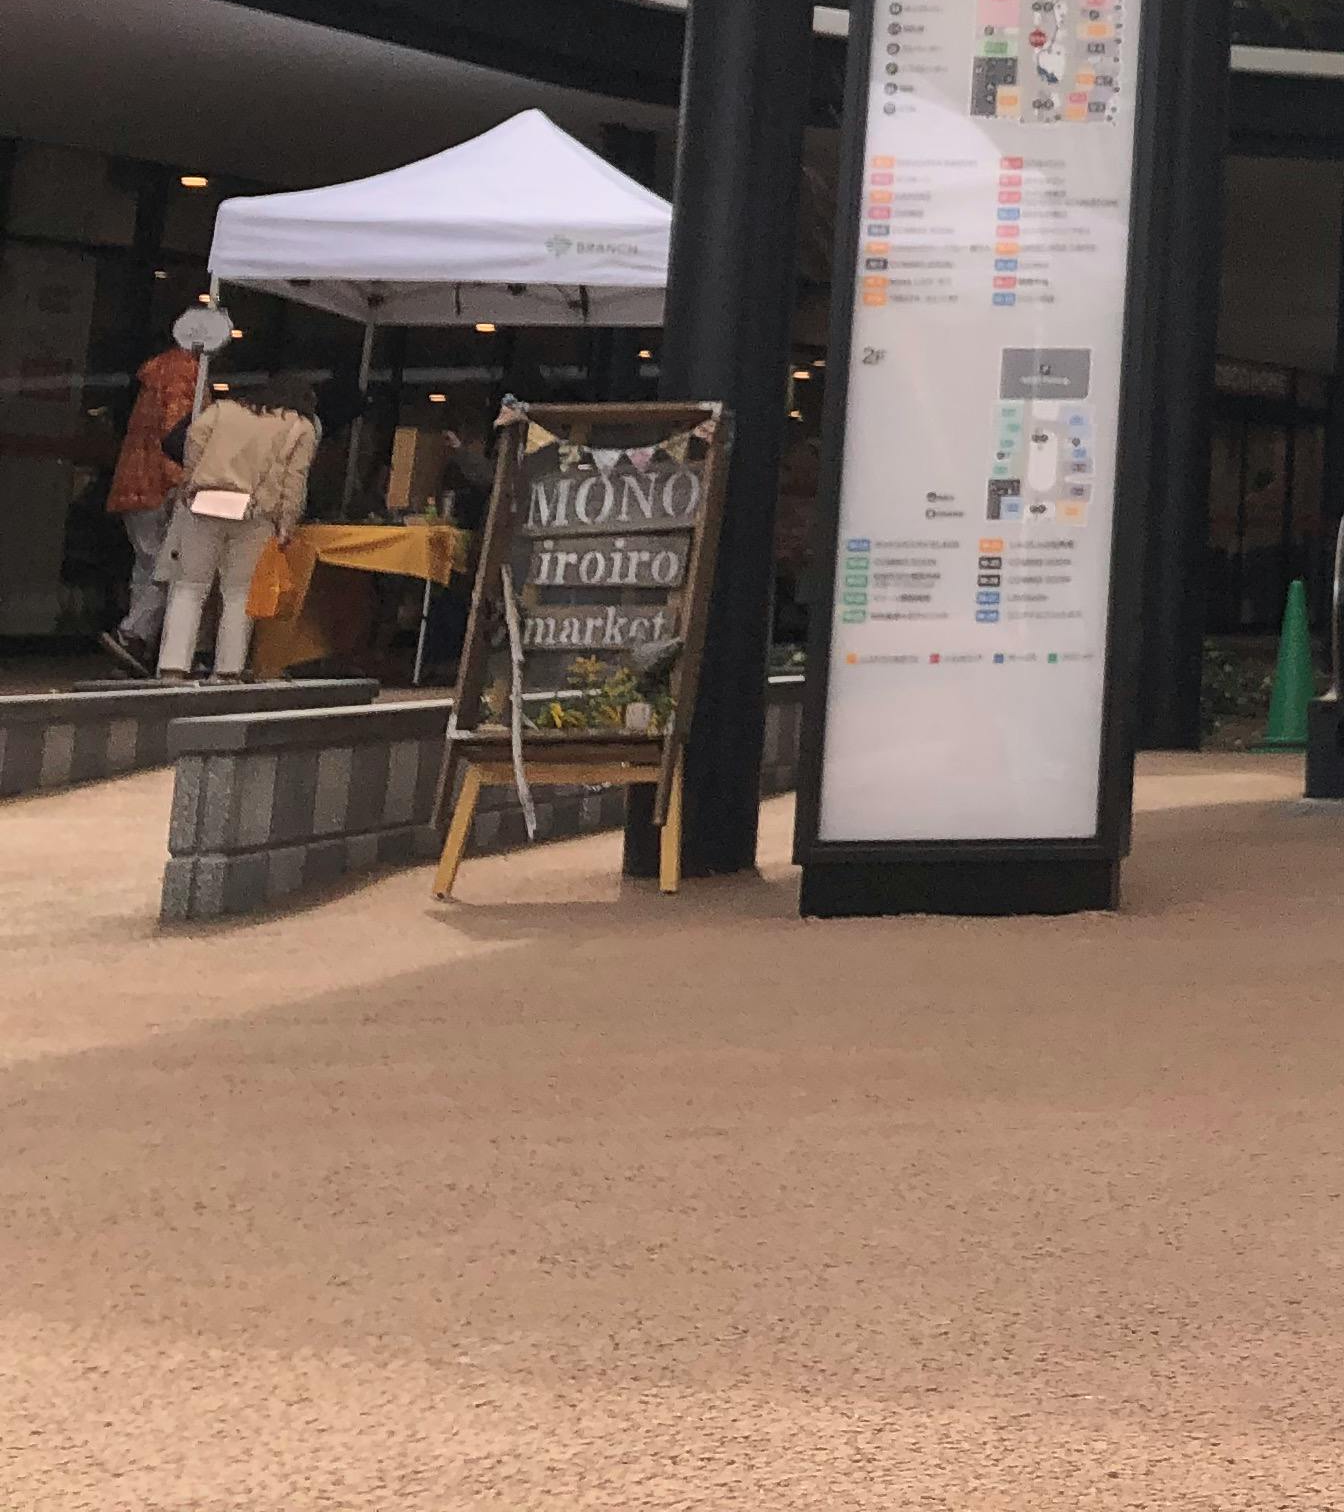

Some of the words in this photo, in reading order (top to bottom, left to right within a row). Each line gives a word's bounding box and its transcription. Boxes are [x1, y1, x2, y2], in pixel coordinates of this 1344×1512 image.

[523, 470, 701, 530] MONO
[534, 538, 680, 585] iroiro
[522, 606, 666, 647] market
